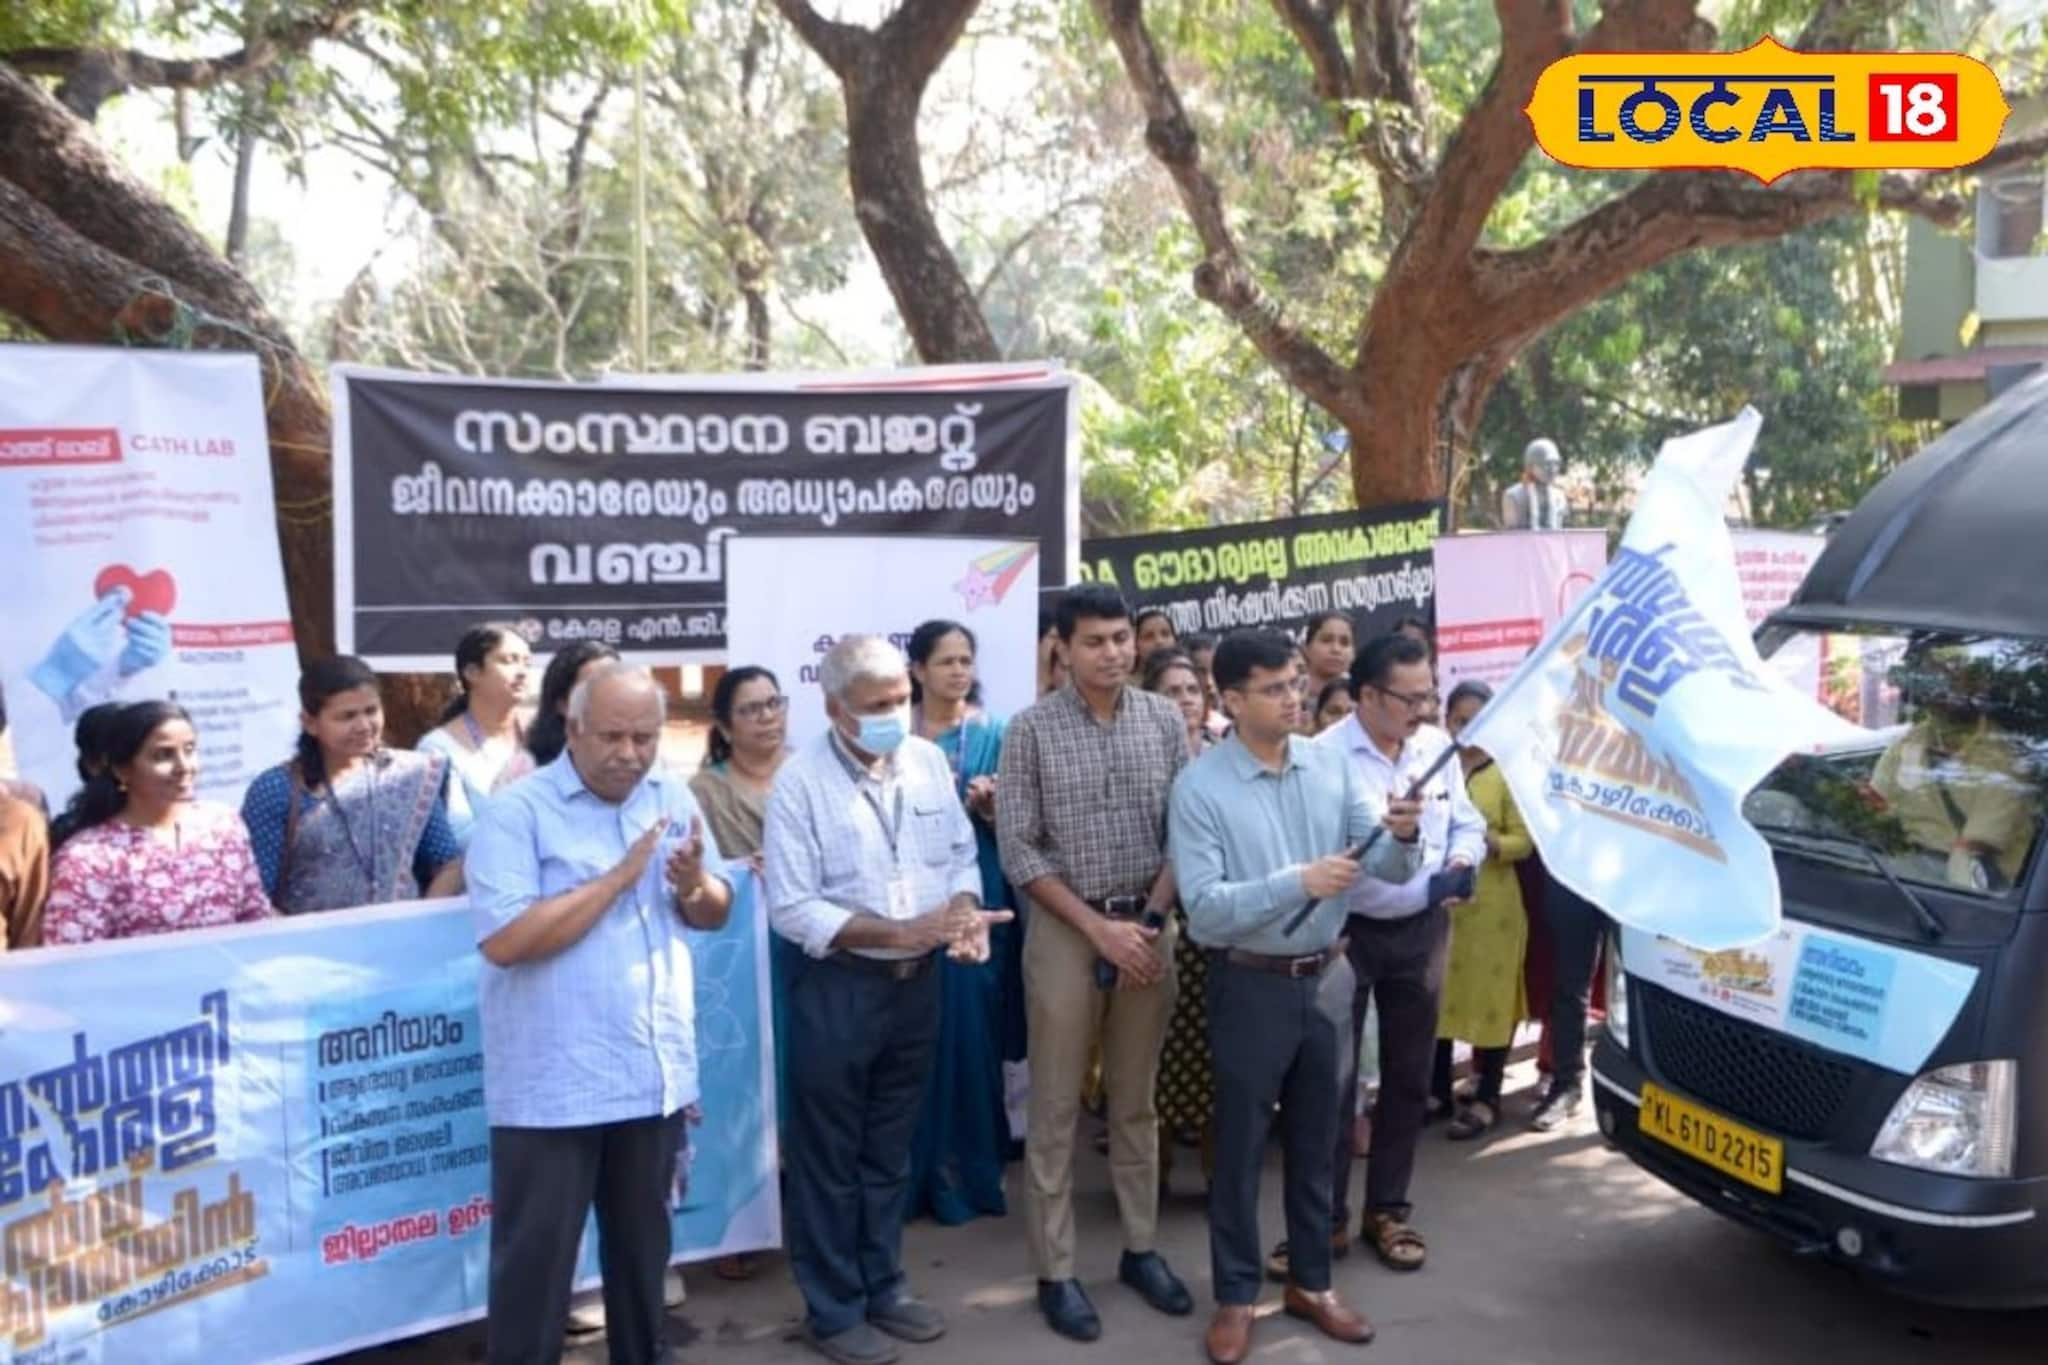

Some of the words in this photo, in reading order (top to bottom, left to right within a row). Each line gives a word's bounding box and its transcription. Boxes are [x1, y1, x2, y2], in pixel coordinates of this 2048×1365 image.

[130, 434, 187, 455] CATH
[193, 437, 236, 457] LAB
[454, 408, 789, 457] സംസ്ഥാന
[803, 401, 984, 471] ബജറ്റ്
[390, 463, 728, 526] ജീവനക്കാരേയും
[737, 473, 1036, 527] അധ്യാപകരേയും
[529, 528, 739, 586] വഞ്ചി
[548, 615, 623, 641] കേരള
[627, 612, 728, 642] എൻ.ജി.
[318, 1010, 464, 1068] അറിയാം
[1654, 1102, 1675, 1136] KL
[1680, 1113, 1701, 1146] 61
[1721, 1132, 1773, 1179] 2215
[323, 1212, 438, 1264] ജില്ലാതല
[97, 1236, 261, 1322] കോഴിക്കോട്
